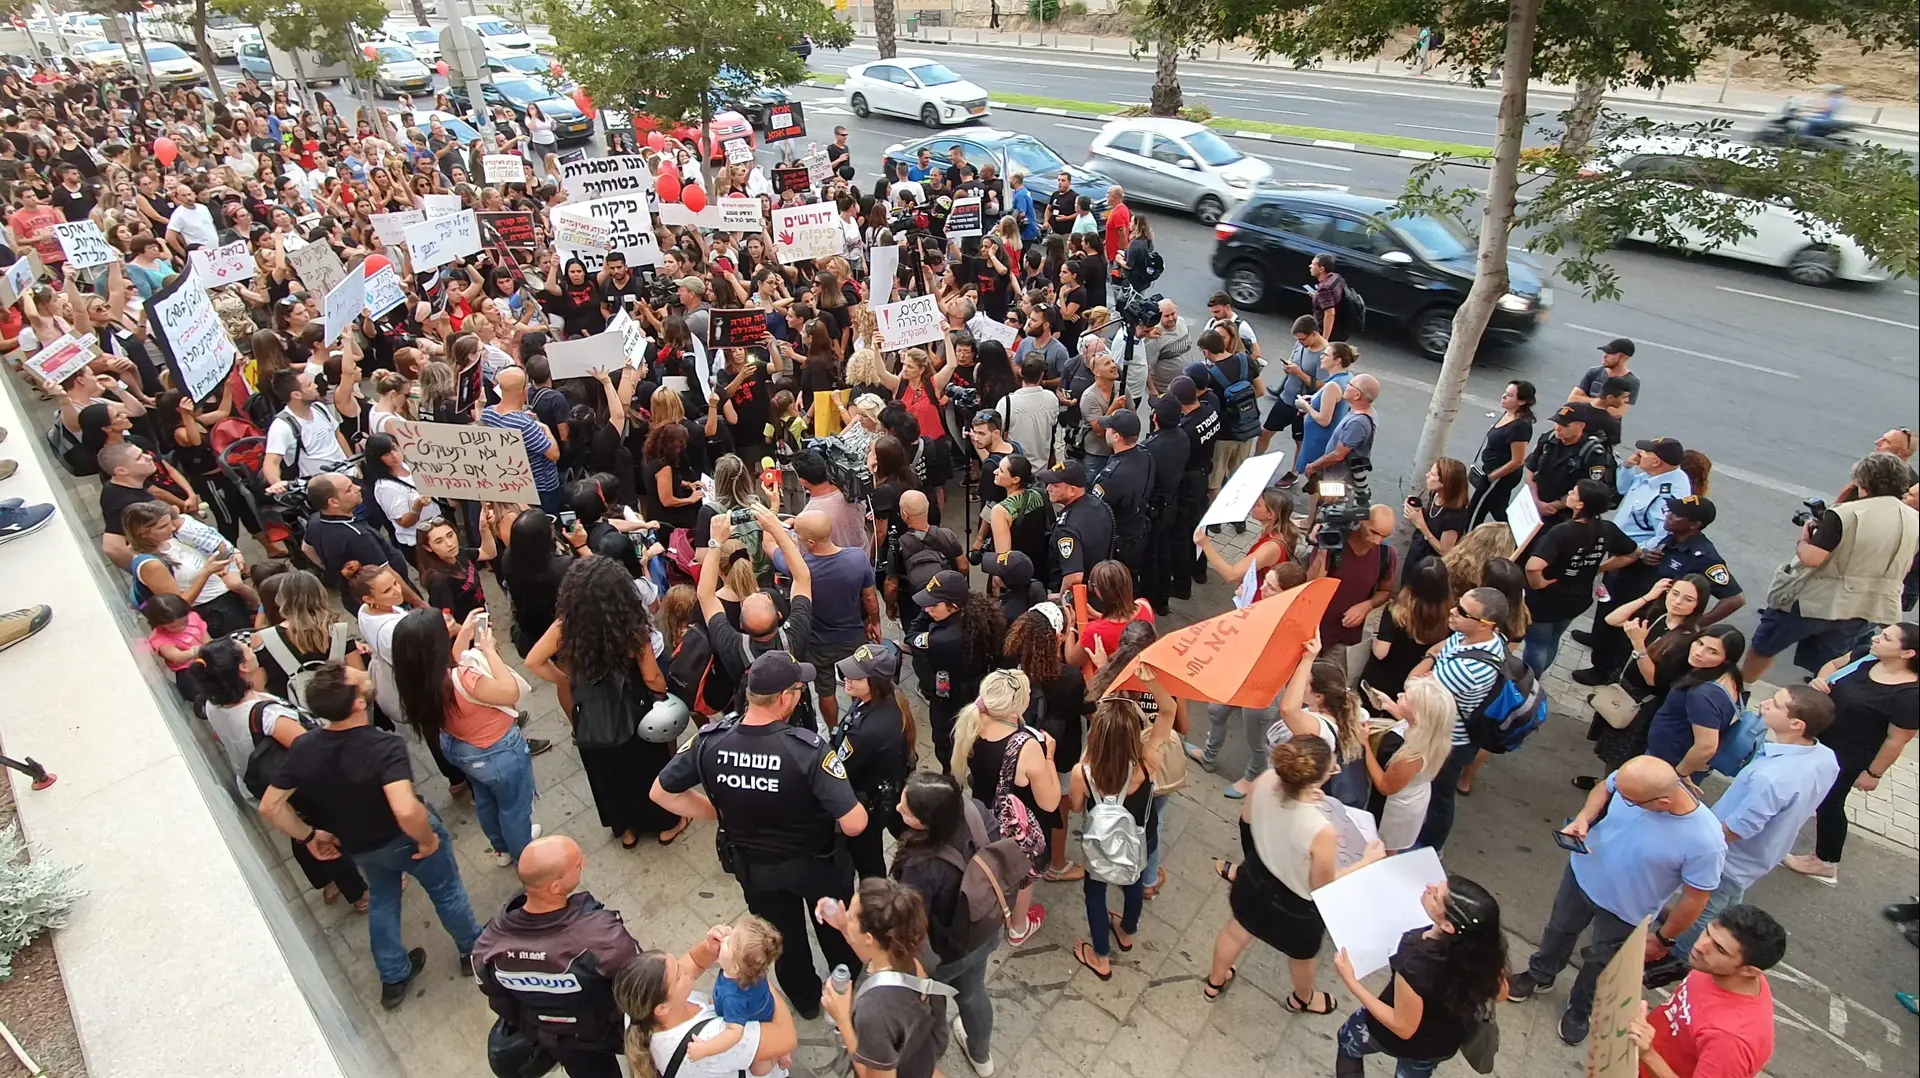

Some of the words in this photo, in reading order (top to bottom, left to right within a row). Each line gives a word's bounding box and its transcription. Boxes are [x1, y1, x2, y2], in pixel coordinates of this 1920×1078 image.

[564, 159, 619, 178] מסגרות
[622, 157, 645, 170] תנו
[583, 175, 639, 194] בטוחות
[590, 199, 638, 220] פיקוח
[784, 211, 832, 228] דורשים
[57, 223, 86, 239] אתם
[799, 227, 836, 244] פיקוח
[73, 246, 108, 263] מלידה
[897, 298, 932, 319] דורשים
[896, 313, 934, 329] הסדרה
[458, 431, 492, 446] תנום
[500, 431, 520, 447] לא
[478, 444, 498, 461] ולא
[463, 464, 488, 479] אם
[495, 463, 520, 479] כל
[716, 750, 782, 771] משטרה
[716, 773, 780, 792] POLICE
[498, 976, 577, 989] משטרה
